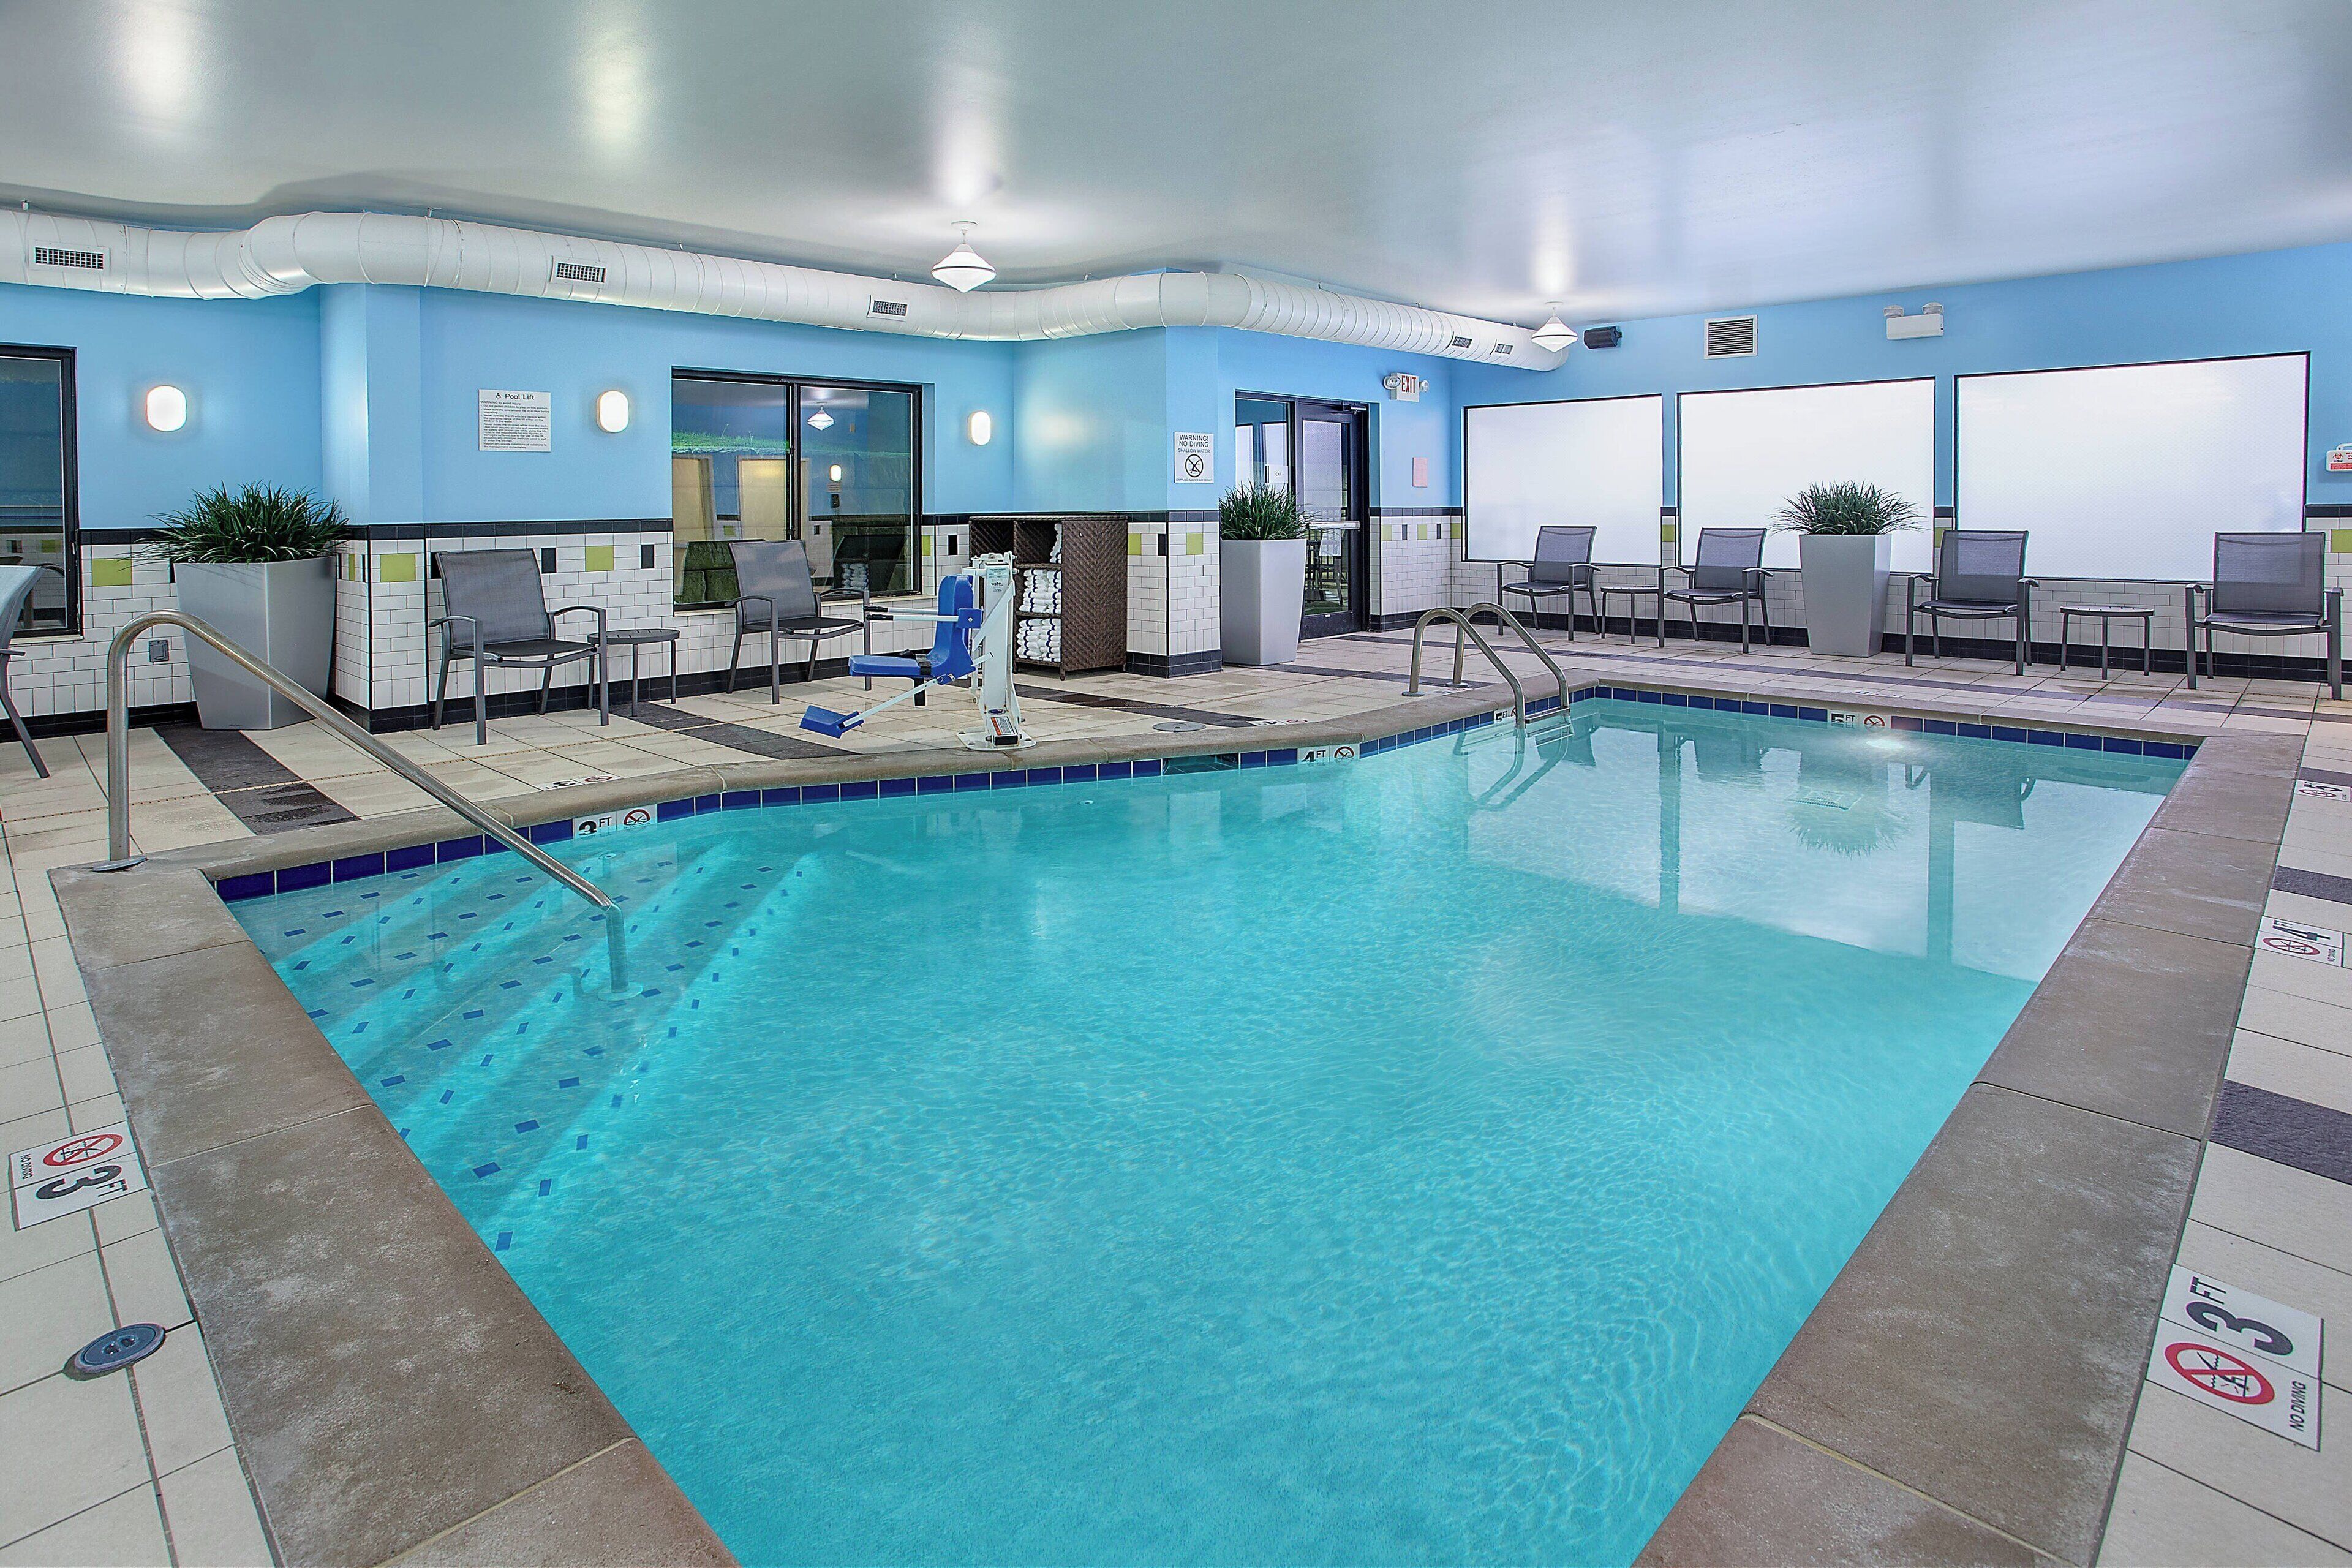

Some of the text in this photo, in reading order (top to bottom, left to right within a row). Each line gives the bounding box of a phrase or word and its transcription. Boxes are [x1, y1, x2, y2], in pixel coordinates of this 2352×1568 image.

[1401, 375, 1417, 393] EXIT
[1496, 712, 1502, 723] 5
[1831, 713, 1845, 723] 5
[1302, 750, 1326, 763] 4 FT
[599, 816, 612, 827] FT
[2272, 919, 2331, 941] 4 FT
[20, 1153, 33, 1180] NO DIVING
[36, 1165, 129, 1200] 3 FT
[2186, 1276, 2293, 1355] 3 FT
[2289, 1381, 2307, 1432] NO DIVING
